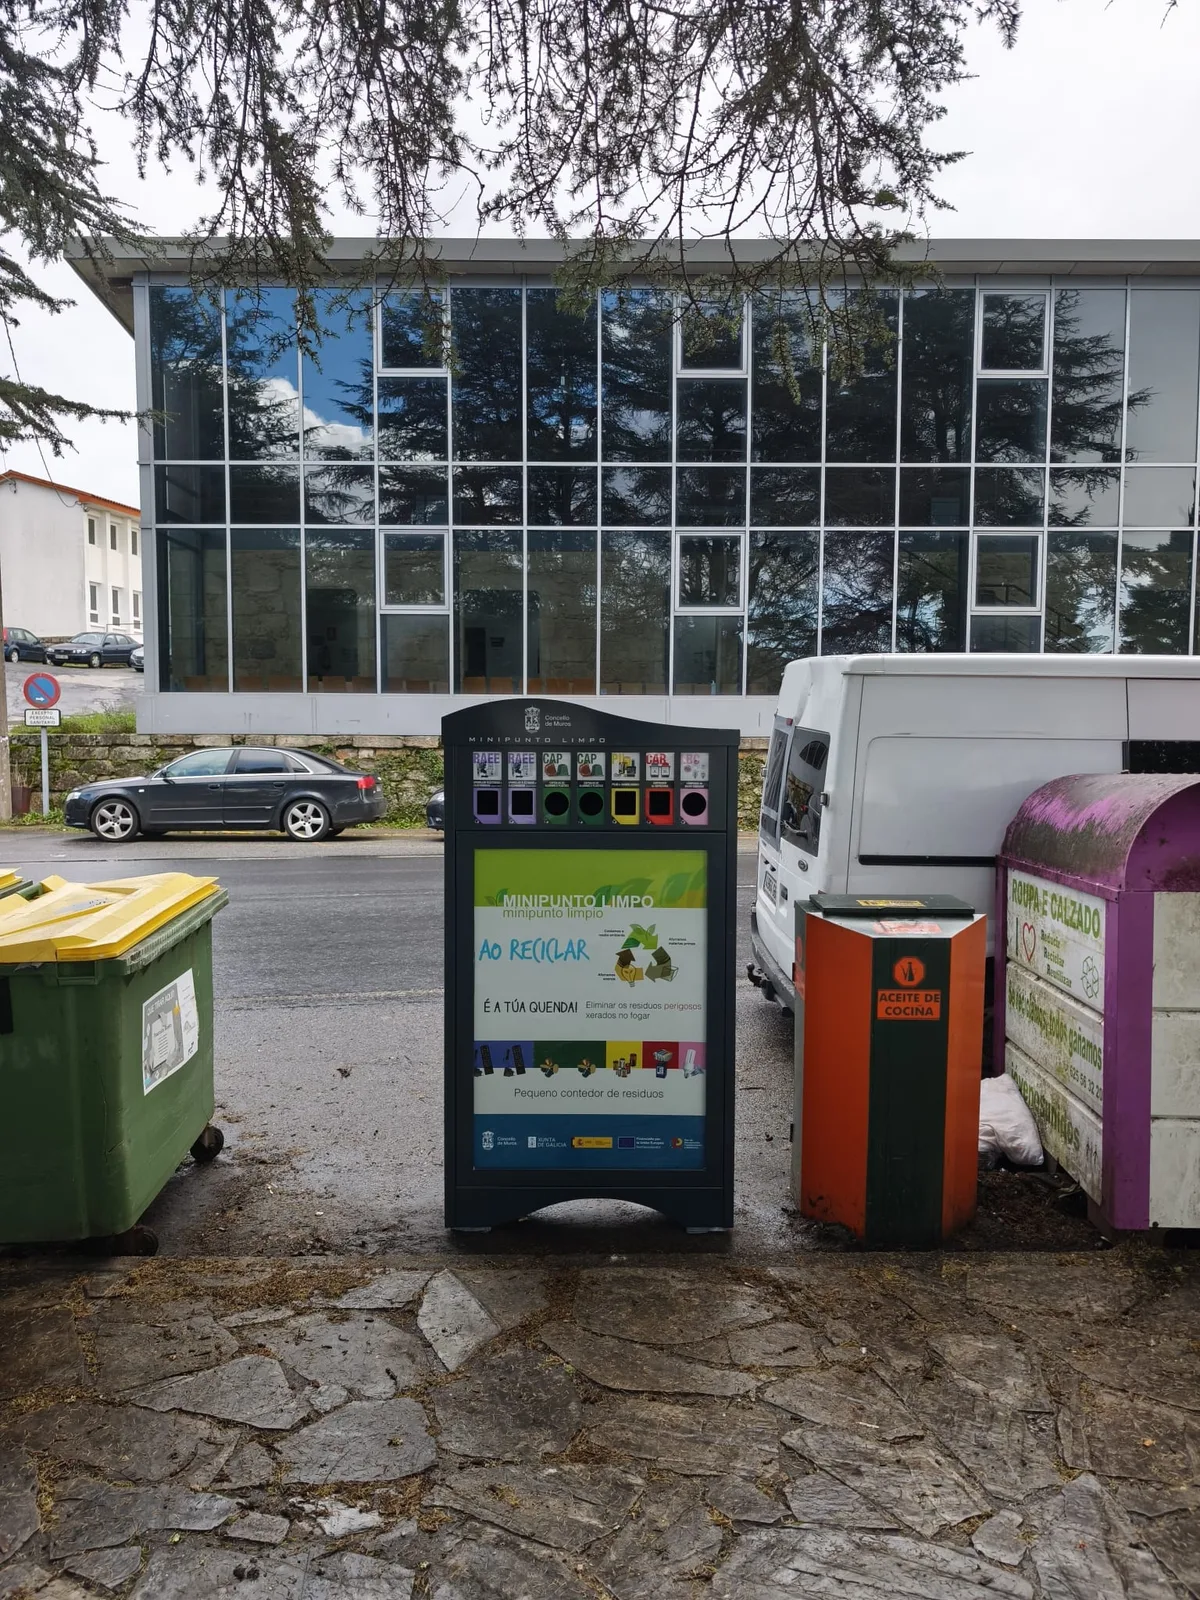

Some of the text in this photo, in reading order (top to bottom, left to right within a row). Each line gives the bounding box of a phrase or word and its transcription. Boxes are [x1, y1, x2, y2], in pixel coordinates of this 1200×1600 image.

[473, 753, 500, 764] RAEE
[508, 753, 534, 764] RAEE
[543, 753, 562, 764] CAP
[577, 753, 596, 764] CAP
[503, 895, 654, 908] MINIPUNTO LIMPO
[502, 907, 604, 921] minipunto limpio
[1012, 878, 1100, 939] ROUPA E CALZADO
[510, 938, 590, 963] RECICLAR
[1044, 947, 1064, 967] Reciclar
[1046, 964, 1072, 988] Reutilizar
[880, 993, 940, 1002] ACEITE DE
[484, 998, 578, 1014] É A TÚA QUENDA!
[586, 1001, 616, 1009] Eliminar
[629, 1001, 662, 1010] residuos
[664, 1002, 702, 1013] perigosos
[630, 1012, 650, 1022] fogar
[514, 1089, 664, 1100] Pequeno contedor de residuos
